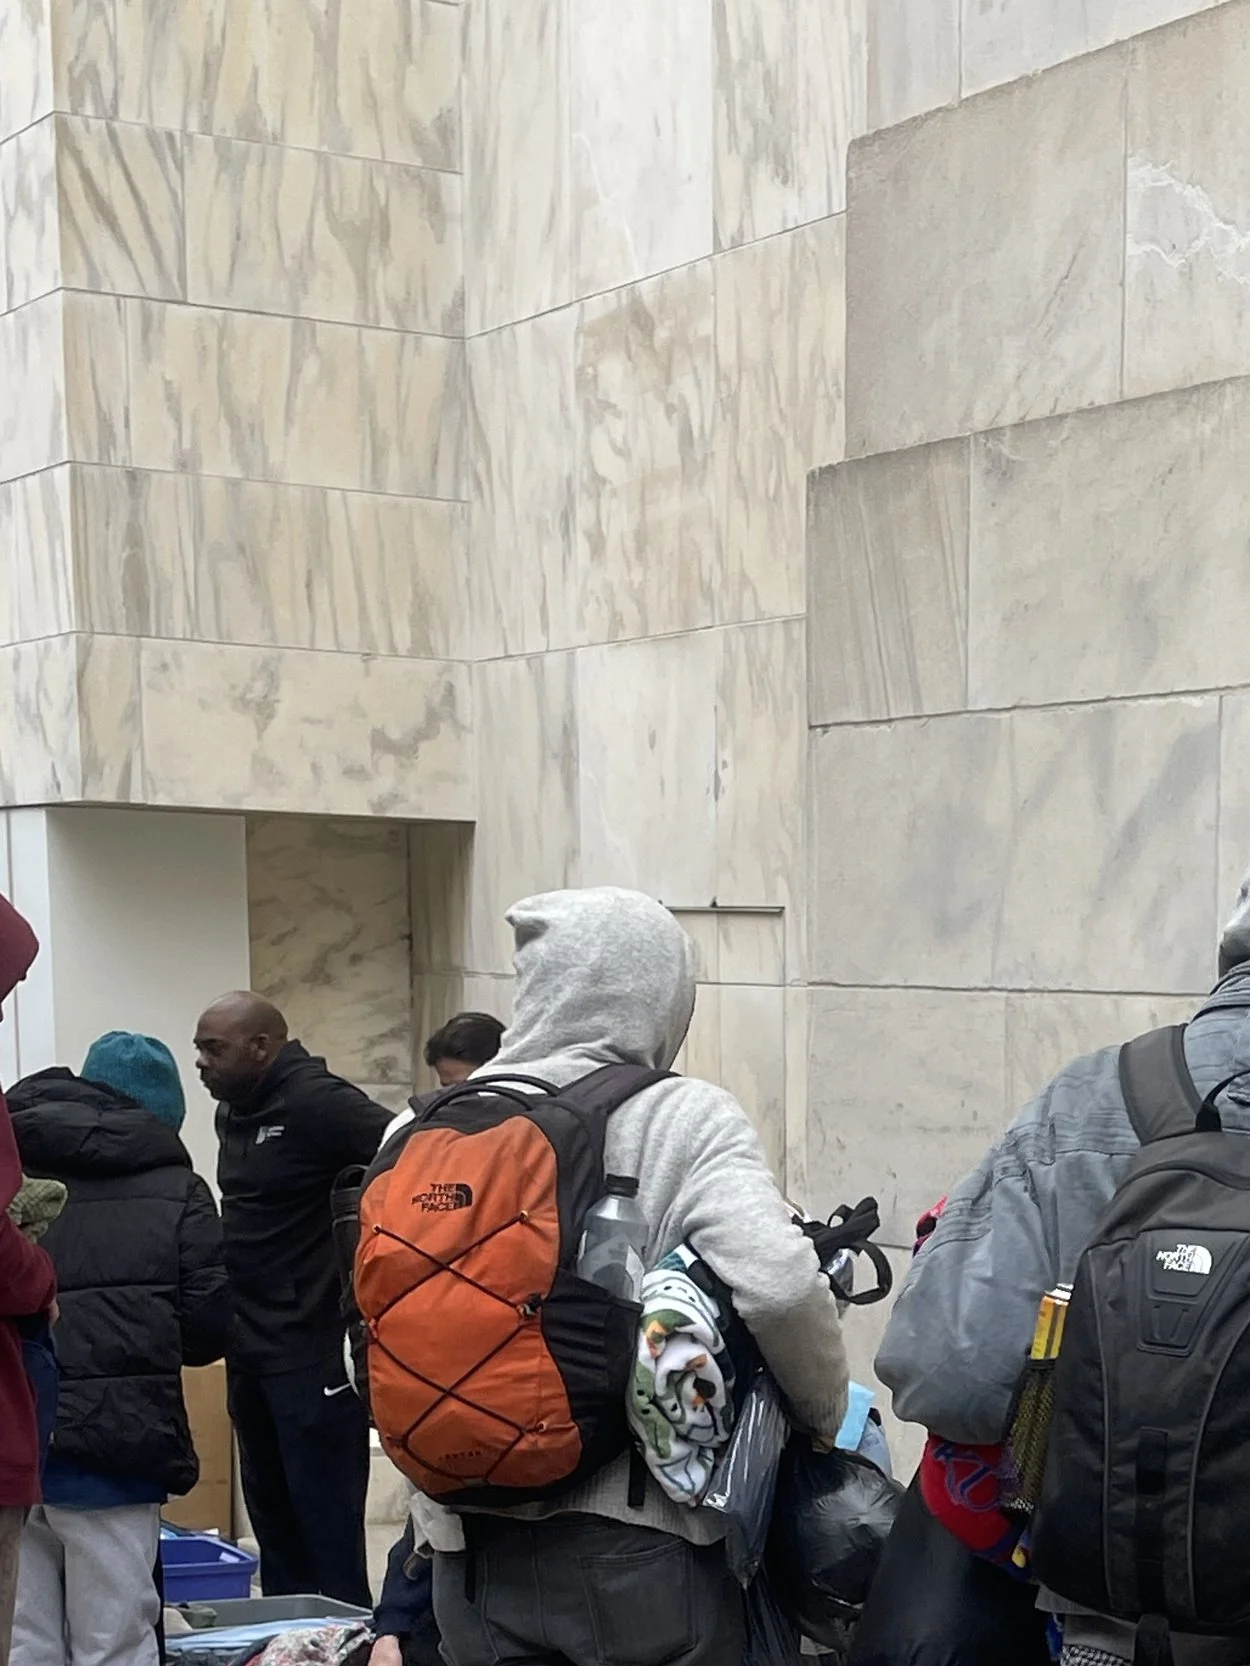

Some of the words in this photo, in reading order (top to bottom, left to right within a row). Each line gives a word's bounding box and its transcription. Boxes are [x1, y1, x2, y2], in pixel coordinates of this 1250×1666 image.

[430, 1183, 456, 1194] THE
[411, 1193, 456, 1205] NORTH
[421, 1202, 455, 1213] FACE
[1156, 1251, 1193, 1263] NORTH
[1164, 1260, 1190, 1271] FACE
